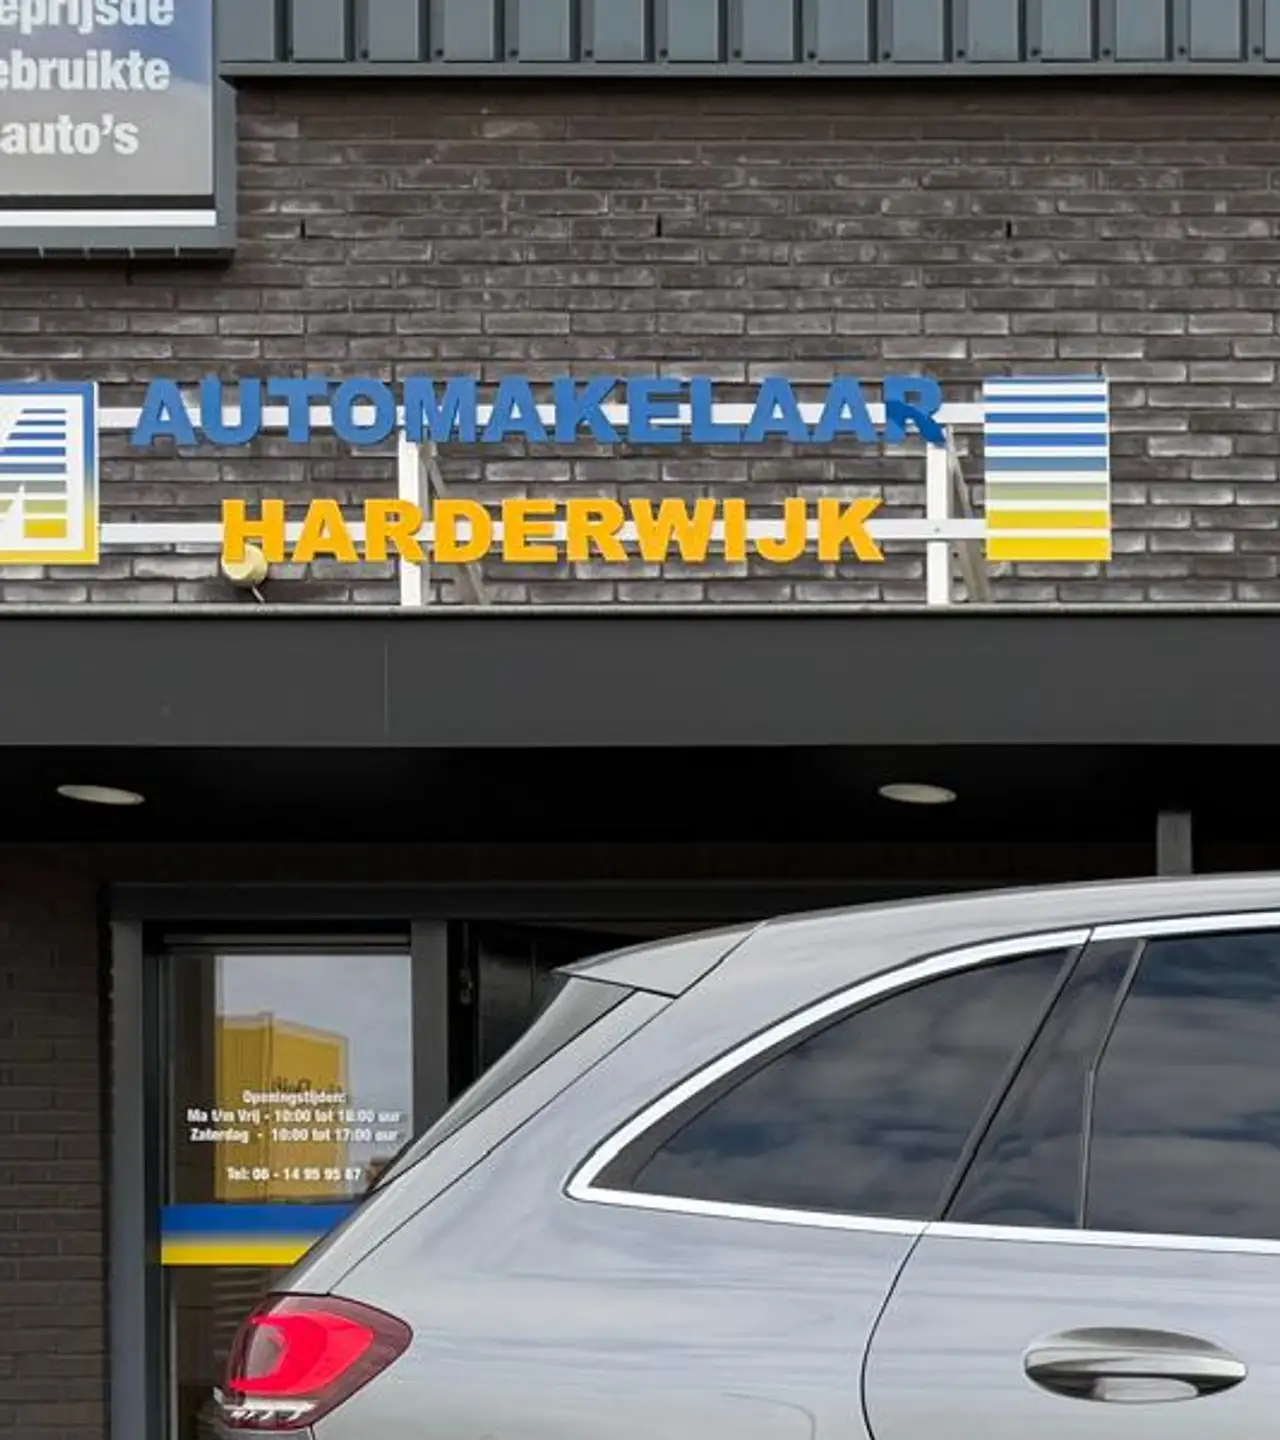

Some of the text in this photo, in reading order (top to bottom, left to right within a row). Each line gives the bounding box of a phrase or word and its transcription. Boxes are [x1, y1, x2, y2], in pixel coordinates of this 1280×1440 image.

[0, 114, 139, 155] auto's
[131, 376, 947, 446] AUTOMAKELAAR
[220, 498, 887, 564] HARDERWIJK
